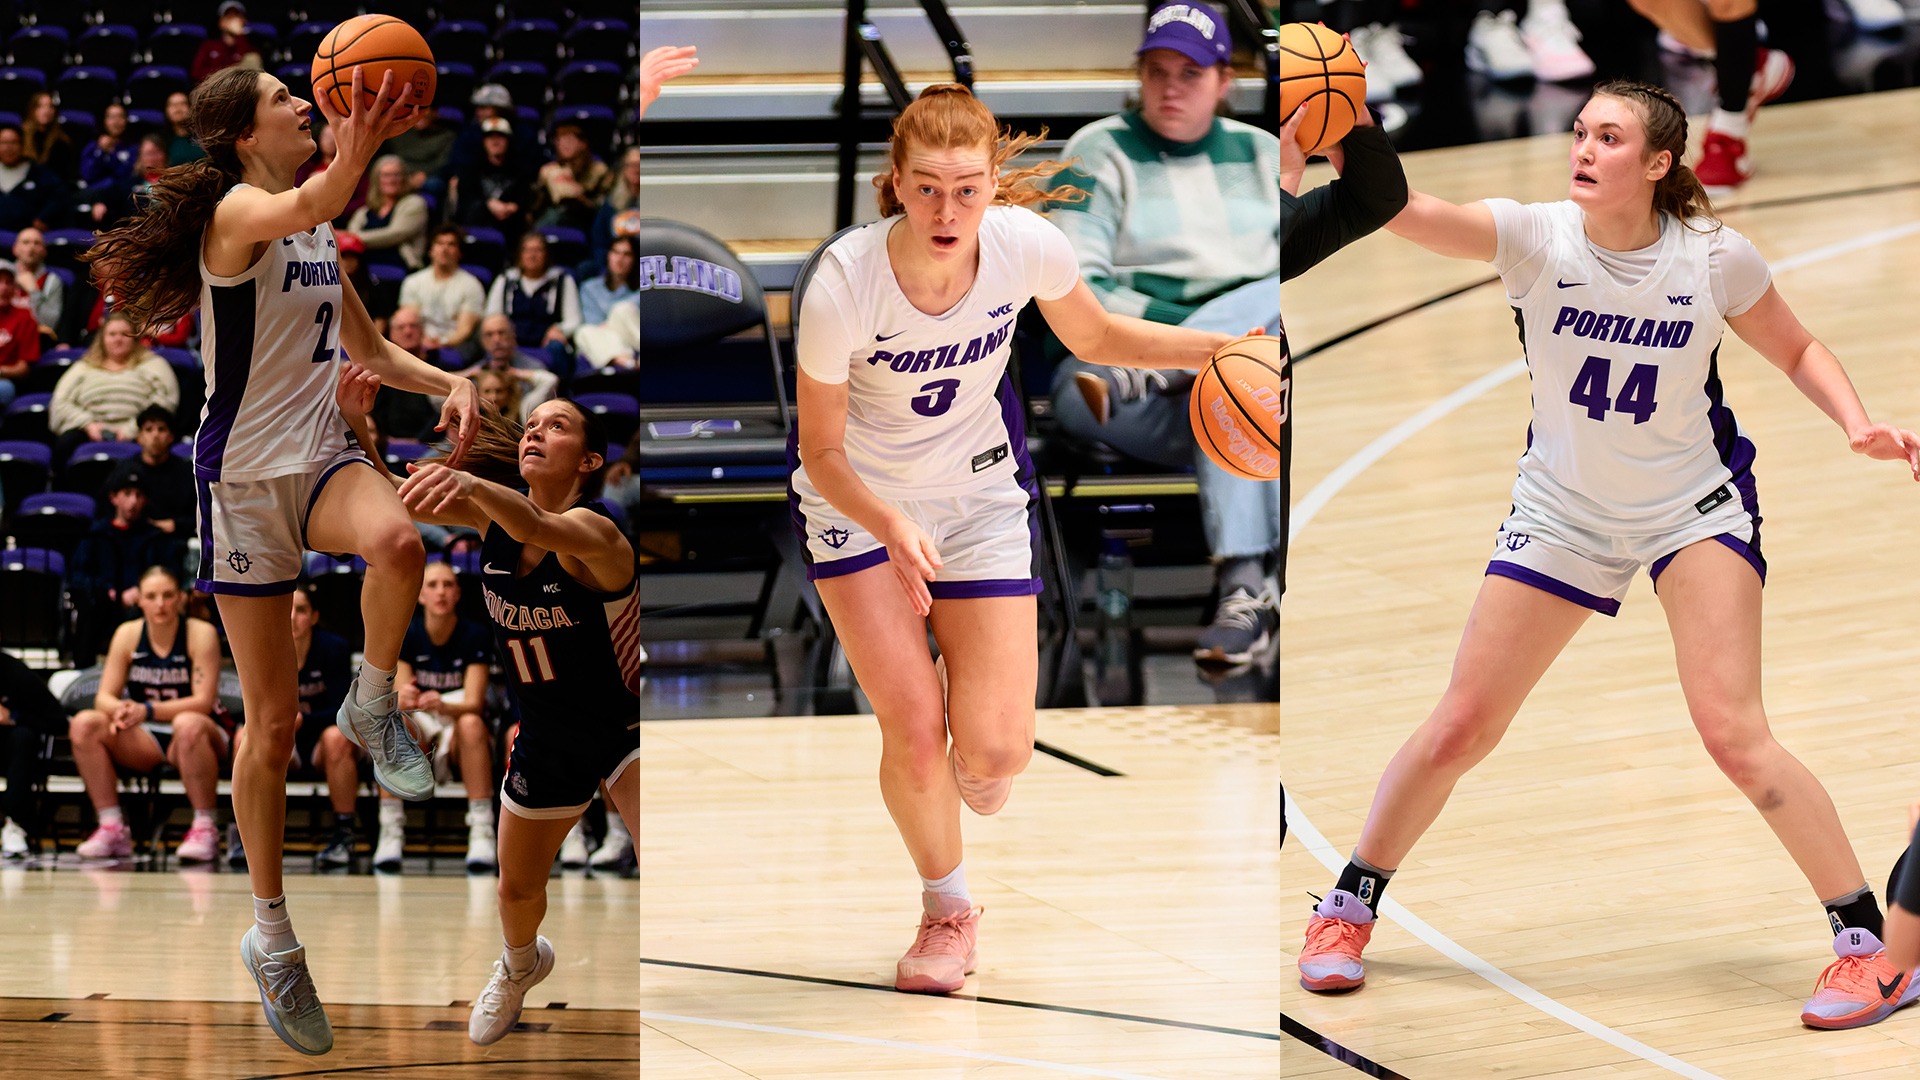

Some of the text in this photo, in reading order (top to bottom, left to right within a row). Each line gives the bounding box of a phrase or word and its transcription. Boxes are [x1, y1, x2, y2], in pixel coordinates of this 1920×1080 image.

[987, 302, 1014, 319] WCC
[1667, 295, 1693, 306] WCC
[311, 301, 335, 363] 2
[867, 318, 1014, 373] PORTLAND
[1552, 306, 1694, 348] PORTLAND
[910, 378, 961, 417] 3
[1569, 355, 1659, 425] 44
[996, 450, 1004, 459] M
[506, 636, 557, 684] 11
